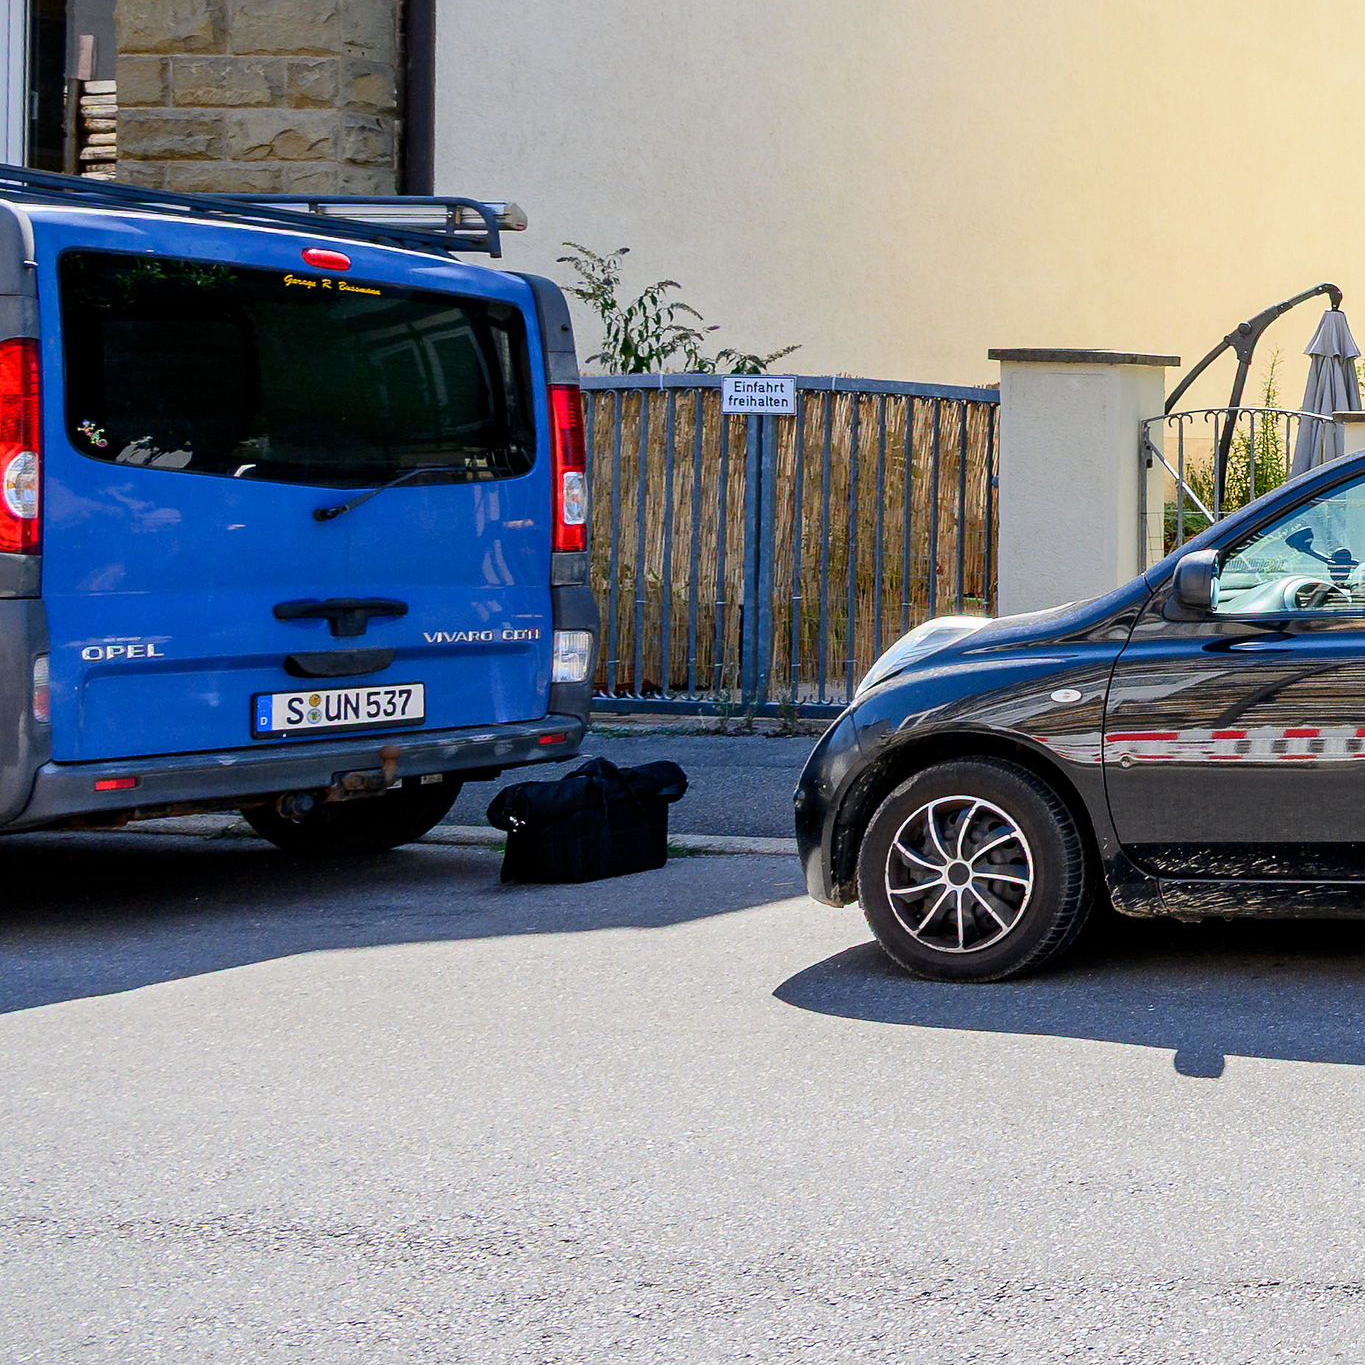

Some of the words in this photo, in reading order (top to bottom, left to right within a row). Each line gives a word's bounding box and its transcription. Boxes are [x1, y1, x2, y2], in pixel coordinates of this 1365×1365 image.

[734, 381, 785, 393] Einfahrt
[728, 395, 788, 407] freihalten
[422, 630, 493, 643] VIVARO
[81, 643, 165, 661] OPEL
[286, 697, 305, 725] S
[325, 692, 360, 721] UN
[366, 689, 412, 718] 537
